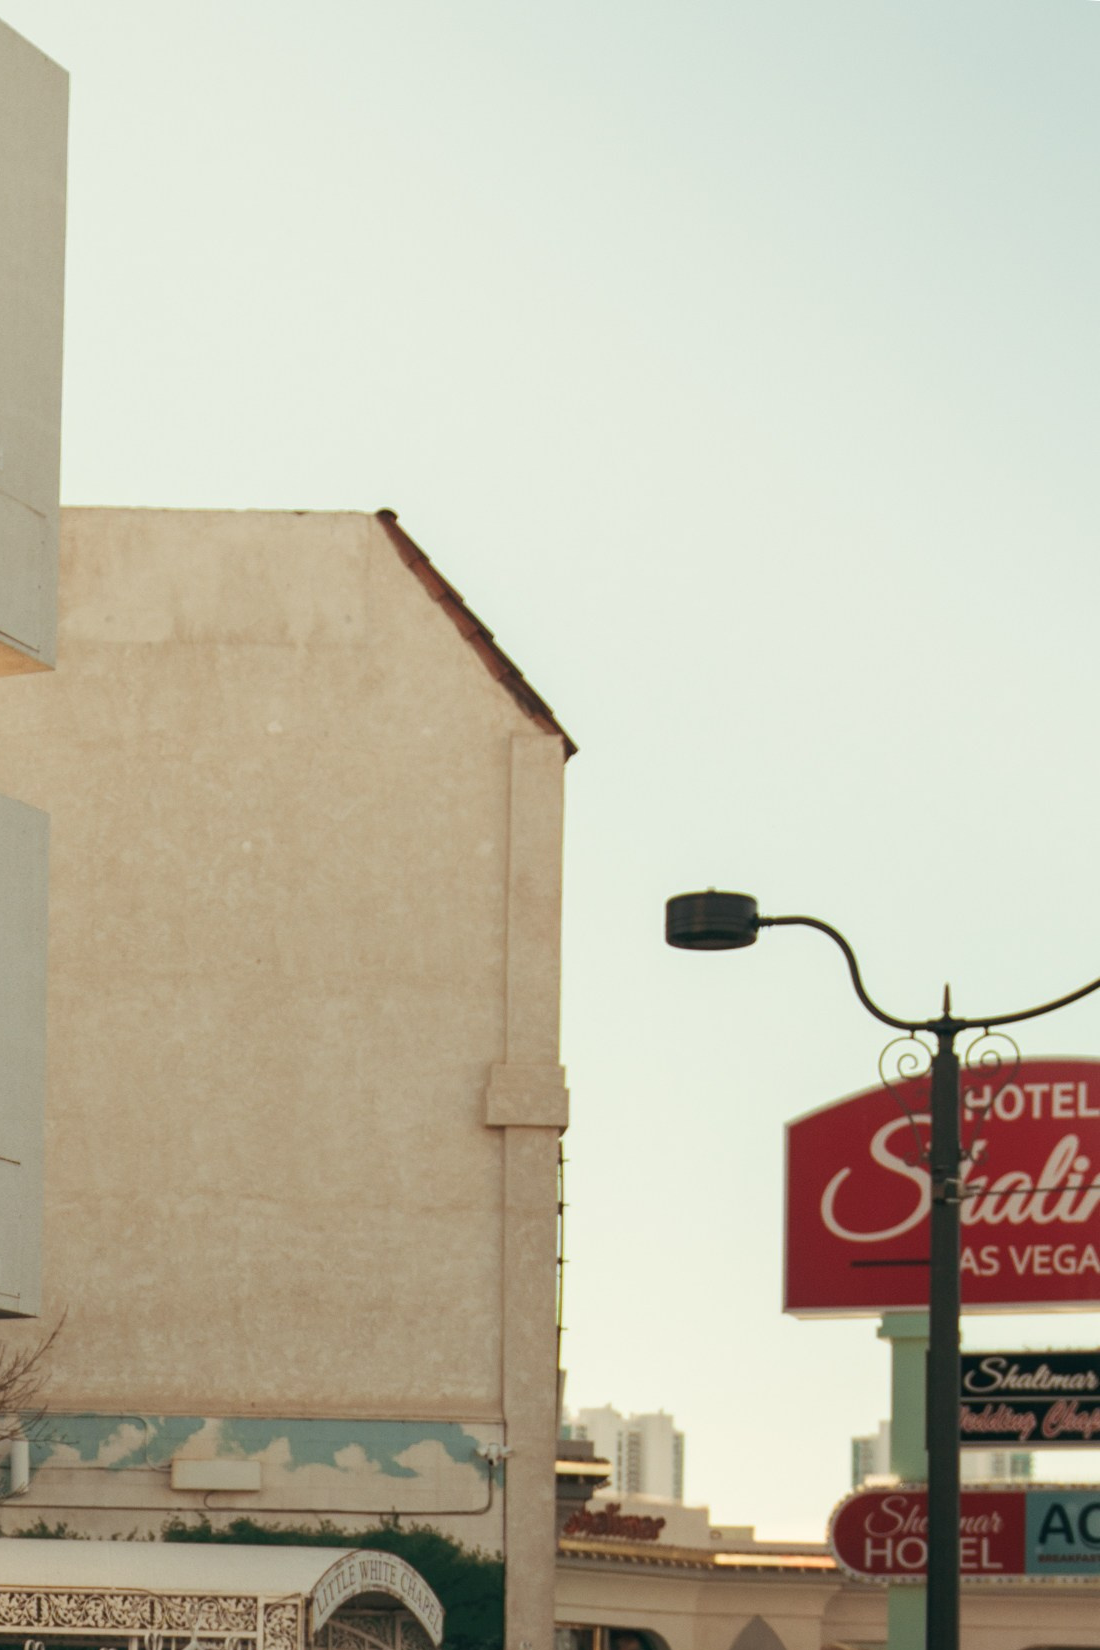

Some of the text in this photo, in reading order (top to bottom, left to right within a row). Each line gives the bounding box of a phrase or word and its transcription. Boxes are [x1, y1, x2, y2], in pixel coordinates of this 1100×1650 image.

[963, 1081, 1100, 1122] HOTEL
[960, 1245, 1100, 1276] AS VEGA
[964, 1356, 1099, 1393] Shalimar
[864, 1537, 1003, 1570] HOEL
[315, 1559, 441, 1635] LITTLE WHITE CHAPEL
